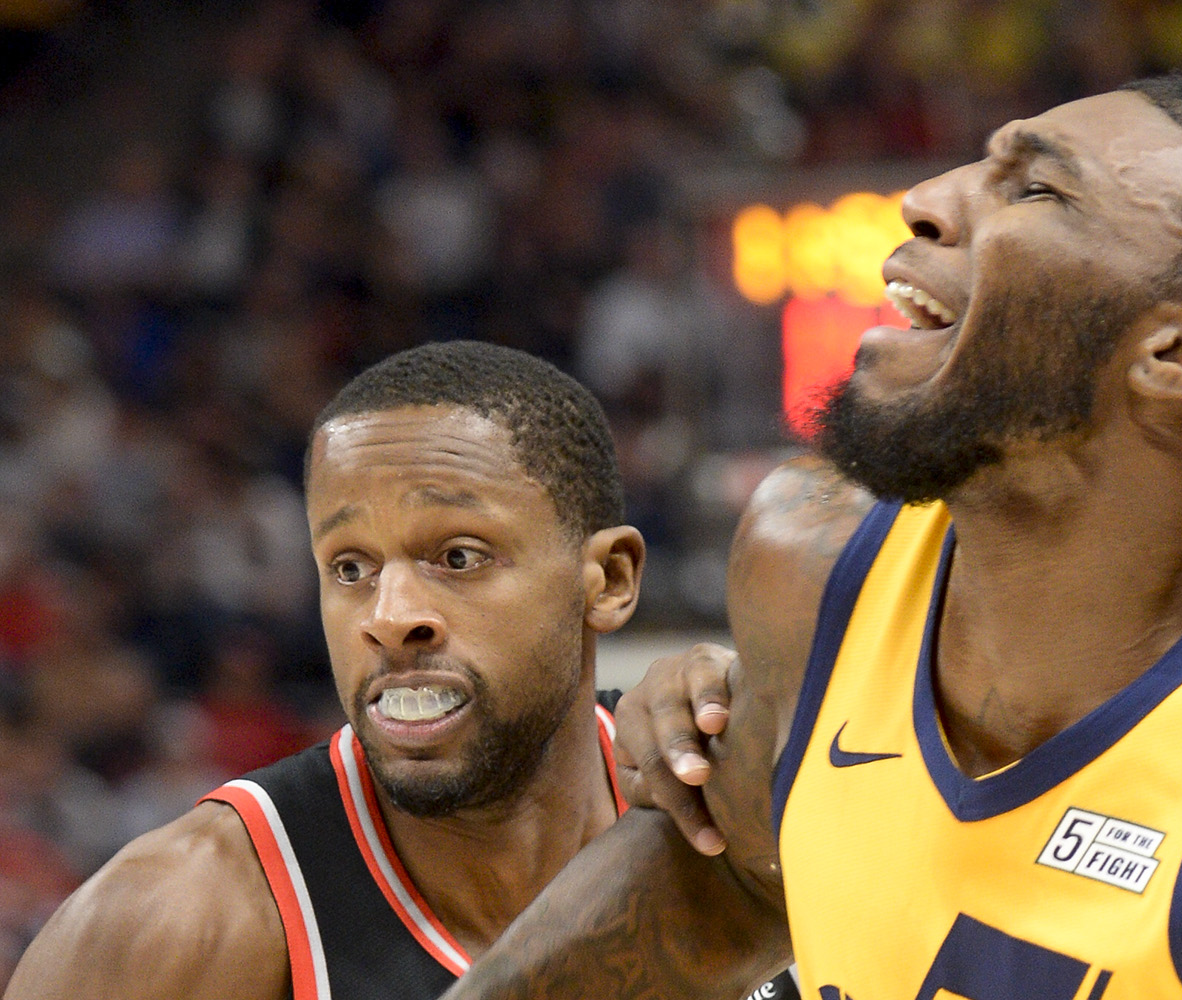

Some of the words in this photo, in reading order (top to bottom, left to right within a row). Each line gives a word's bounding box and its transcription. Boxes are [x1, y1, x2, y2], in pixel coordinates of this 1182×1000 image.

[1053, 818, 1093, 862] 5
[1106, 827, 1130, 841] FOR
[1132, 836, 1155, 849] THE
[1086, 851, 1149, 883] FIGHT
